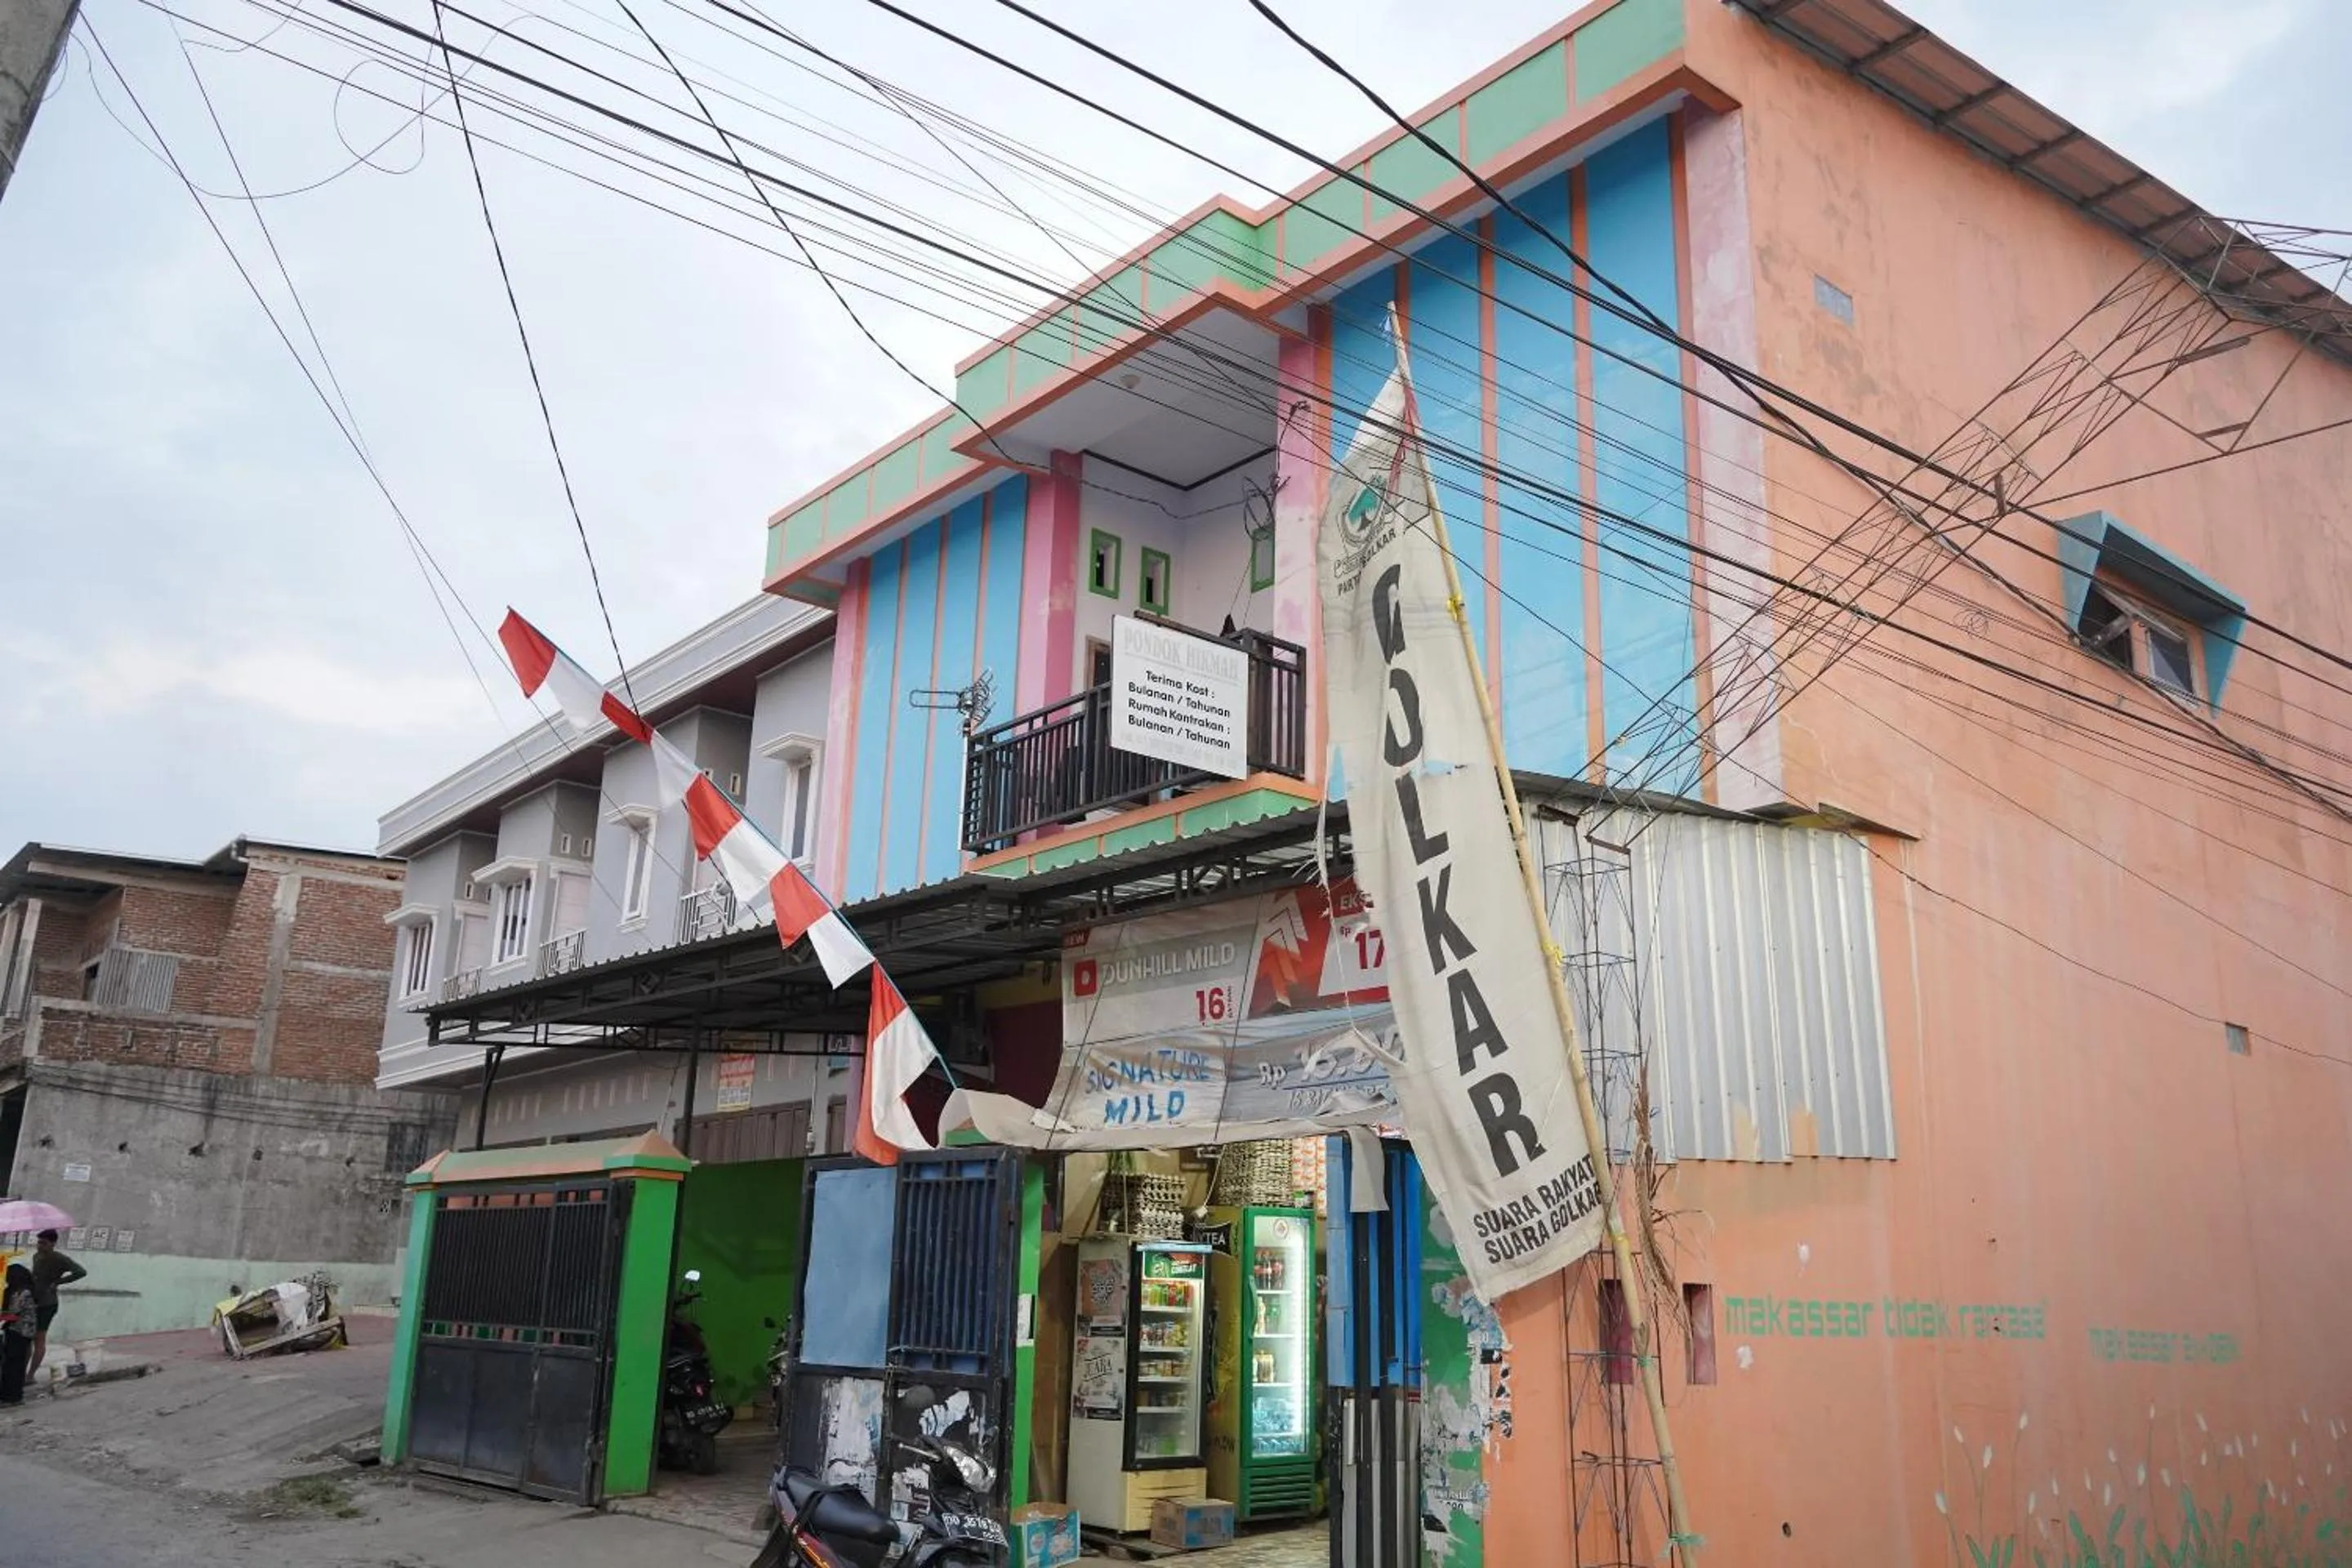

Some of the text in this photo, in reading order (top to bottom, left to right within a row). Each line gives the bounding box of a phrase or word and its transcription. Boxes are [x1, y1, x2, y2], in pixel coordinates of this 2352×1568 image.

[1129, 681, 1174, 703] Bulanan
[1186, 697, 1230, 718] Tahunan
[1146, 670, 1183, 689] Terima
[1129, 697, 1168, 717] Rumah
[1169, 709, 1223, 733] Kontrakan
[1129, 714, 1174, 735] Bulanan
[1186, 728, 1230, 750] Tahunan
[1371, 563, 1547, 1178] GOLKAR
[1103, 942, 1236, 986] DUNHILL MILD
[1196, 987, 1226, 1021] 16
[1085, 1049, 1210, 1094] SIGNATURE
[1103, 1090, 1185, 1125] MILD
[1473, 1153, 1596, 1238] SUARA RAKYAT
[1484, 1218, 1551, 1264] SUARA
[1724, 1292, 1873, 1339] makassar
[1882, 1295, 1951, 1339] tidak
